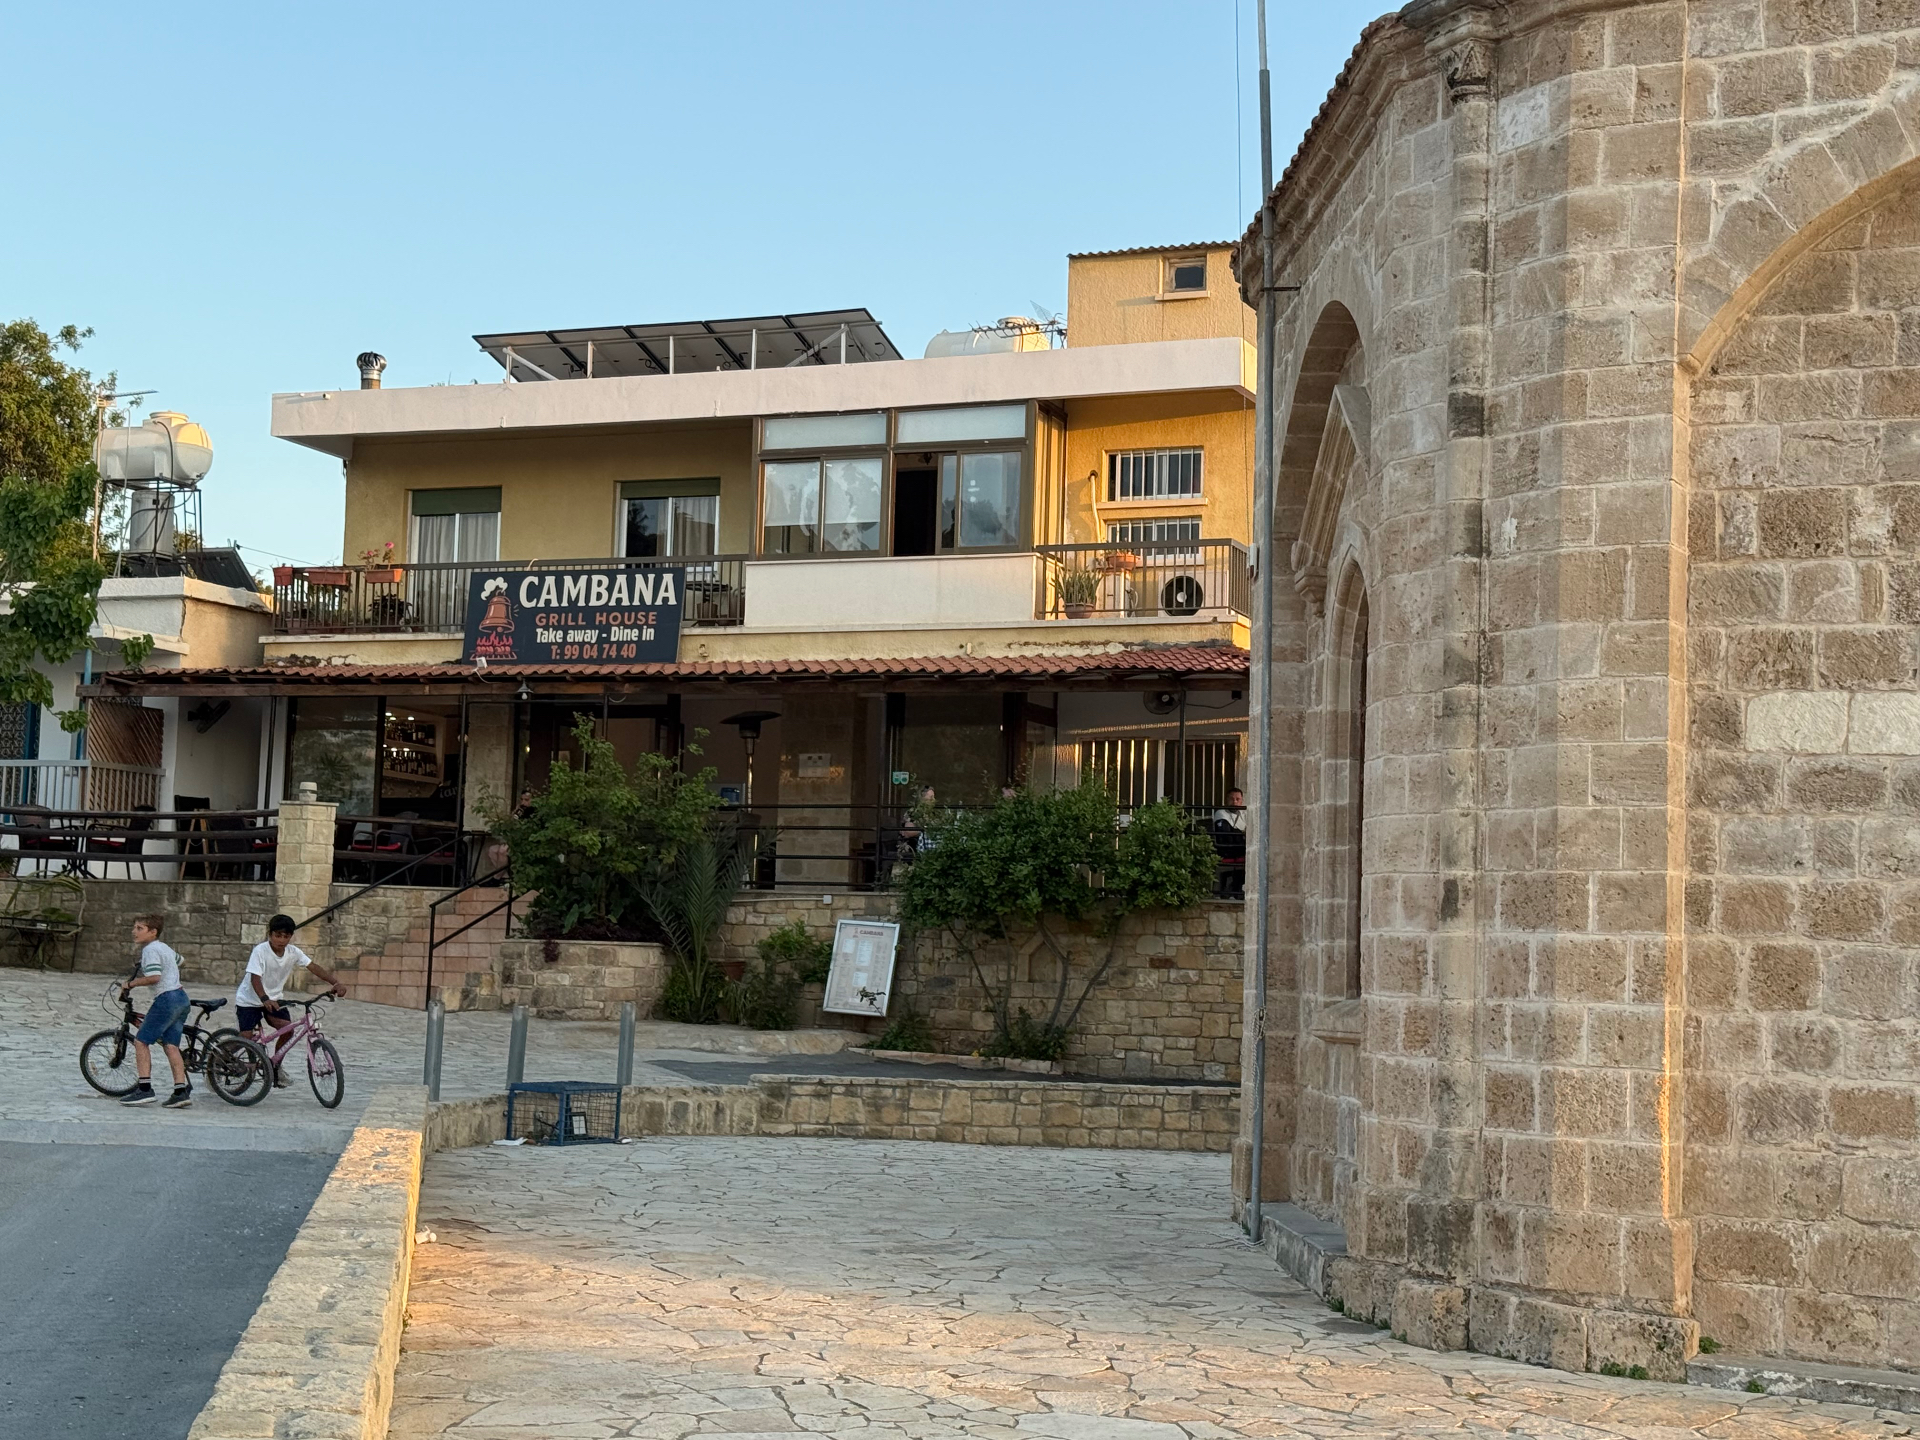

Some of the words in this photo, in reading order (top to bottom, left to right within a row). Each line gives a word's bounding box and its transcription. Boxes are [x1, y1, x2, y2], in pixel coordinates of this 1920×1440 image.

[520, 573, 677, 608] CAMBANA
[536, 613, 586, 626] GRILL
[596, 611, 657, 625] HOUSE
[536, 628, 563, 643] Take
[567, 629, 599, 644] away
[611, 626, 639, 642] Dine
[642, 625, 654, 641] in
[551, 645, 561, 659] T:
[564, 644, 579, 659] 99
[583, 644, 598, 659] 04
[603, 644, 617, 659] 74
[621, 643, 636, 658] 40
